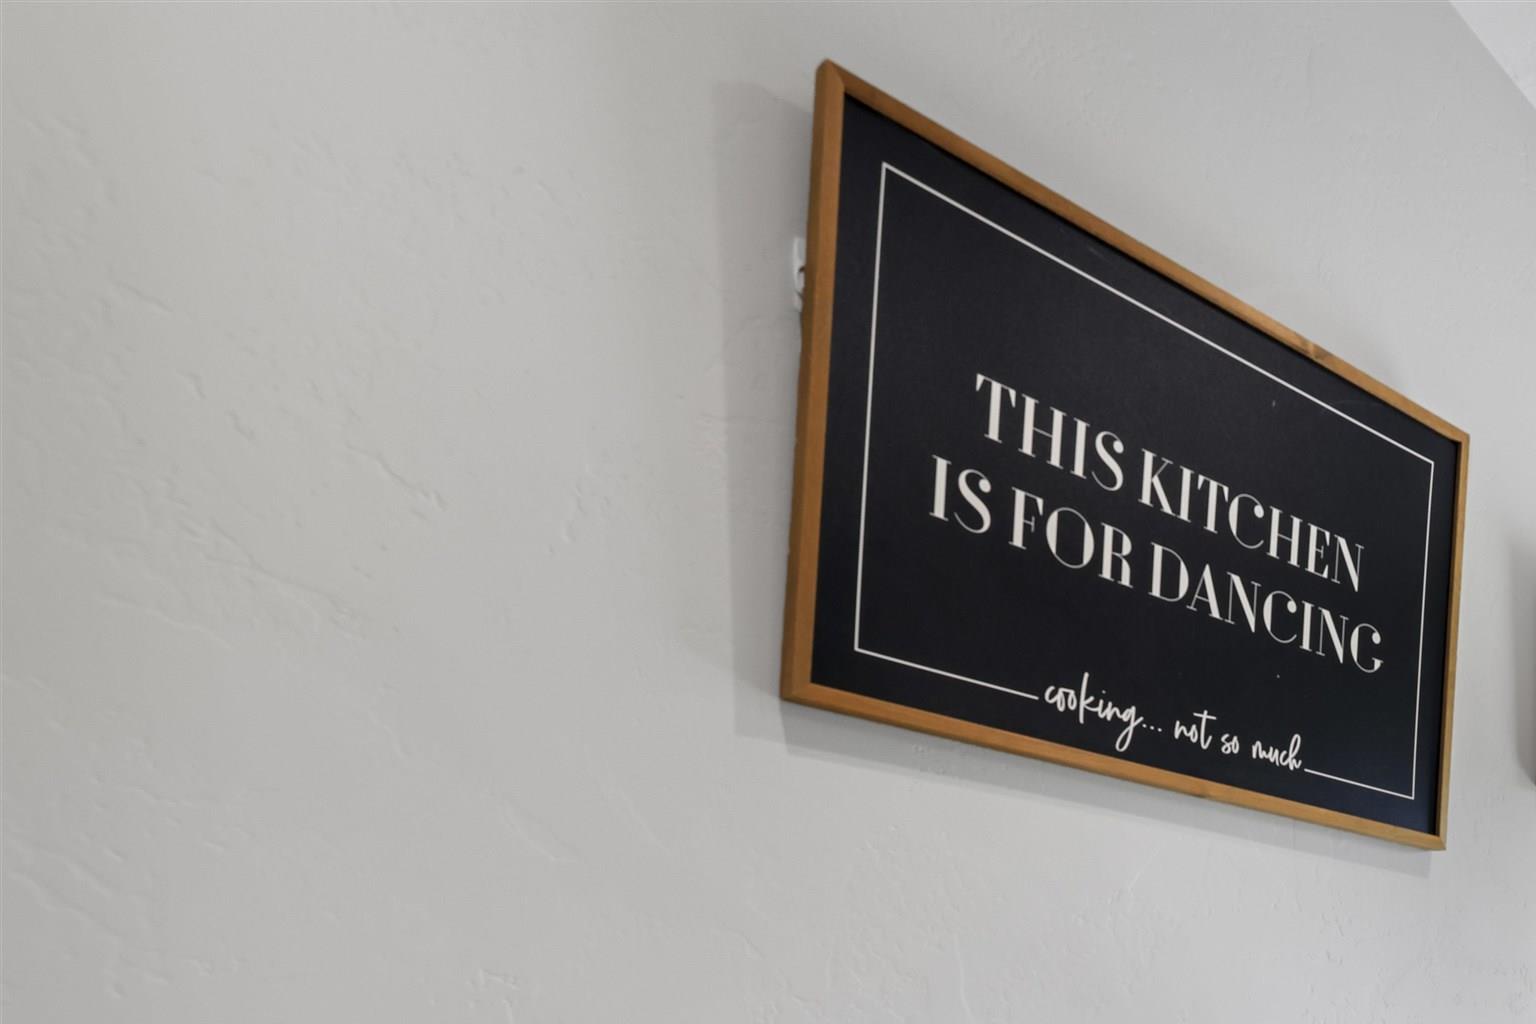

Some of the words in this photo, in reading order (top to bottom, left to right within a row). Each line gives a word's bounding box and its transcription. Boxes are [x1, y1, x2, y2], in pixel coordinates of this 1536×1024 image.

[929, 454, 992, 534] IS
[1008, 487, 1134, 589] FOR
[1148, 541, 1384, 675] DANCING
[975, 374, 1125, 492] THIS
[1139, 448, 1365, 593] KITCHEN
[1044, 671, 1163, 752] cooking...
[1173, 709, 1217, 750] not
[1220, 732, 1240, 755] so
[1250, 733, 1303, 770] much
